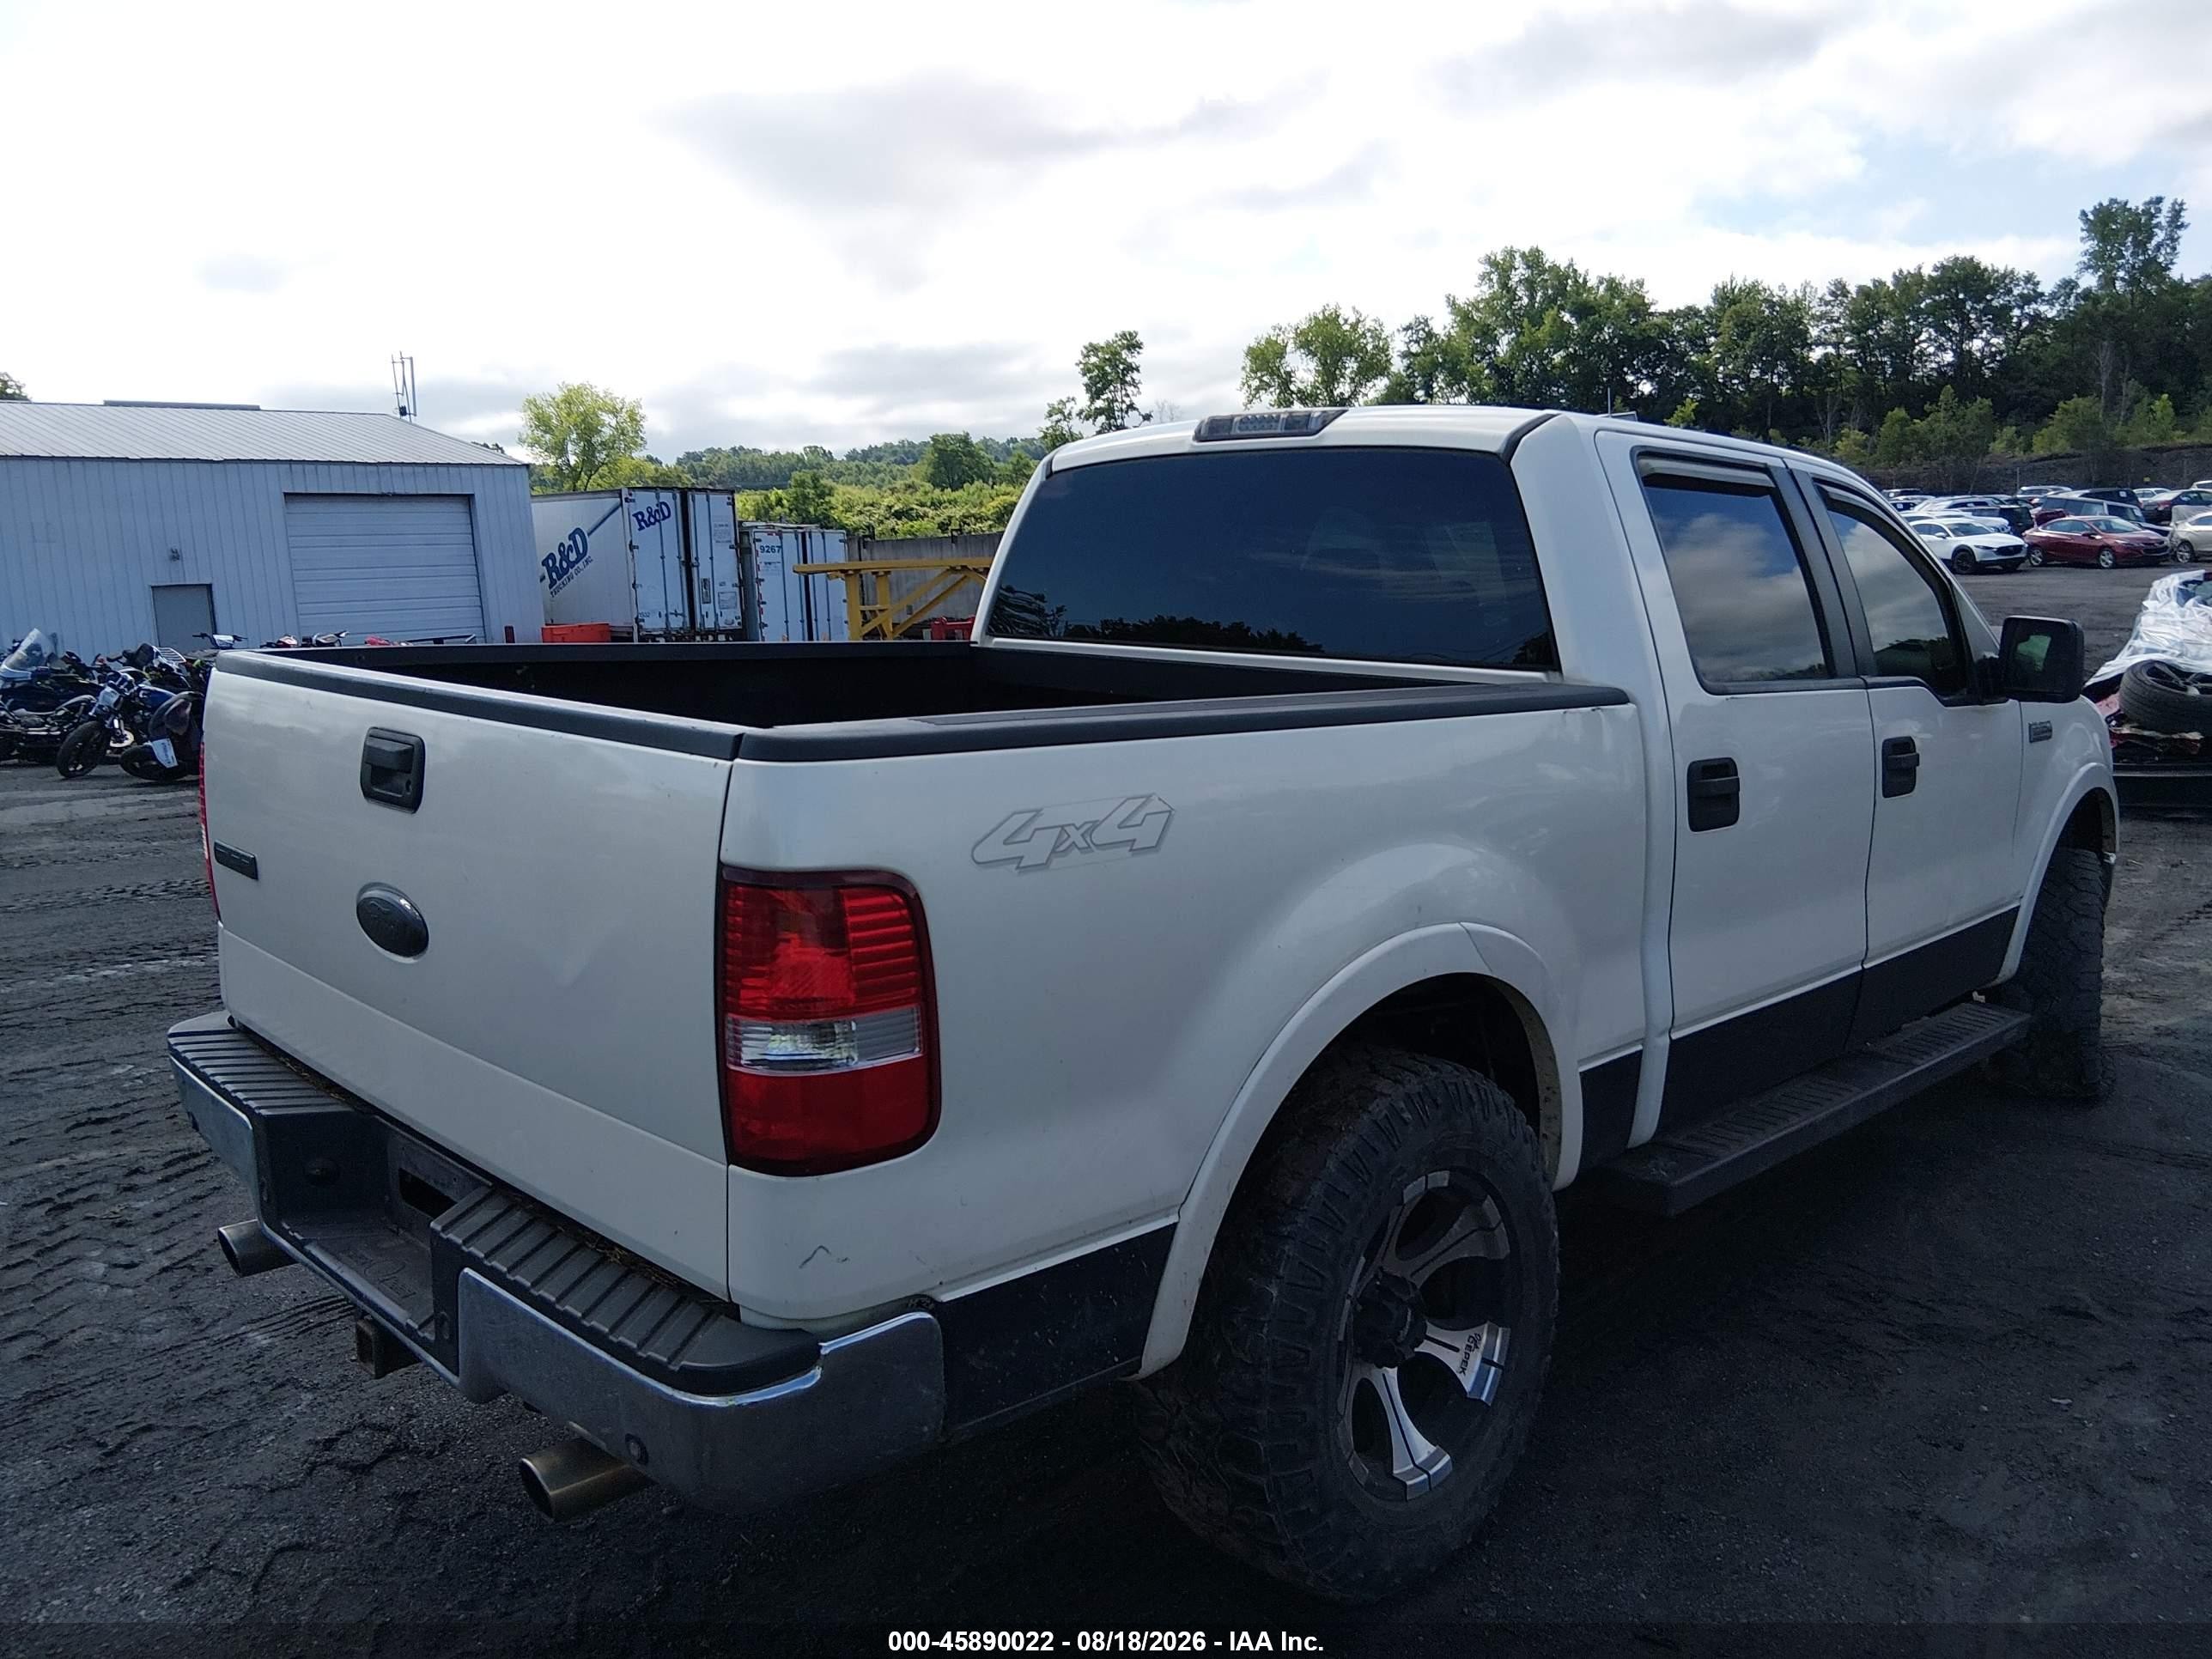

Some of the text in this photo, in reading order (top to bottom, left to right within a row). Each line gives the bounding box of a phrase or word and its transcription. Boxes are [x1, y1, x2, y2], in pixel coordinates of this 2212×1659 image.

[632, 501, 672, 531] R&D
[542, 527, 588, 589] R&D
[760, 545, 782, 554] 9267
[971, 793, 1175, 872] 4x4
